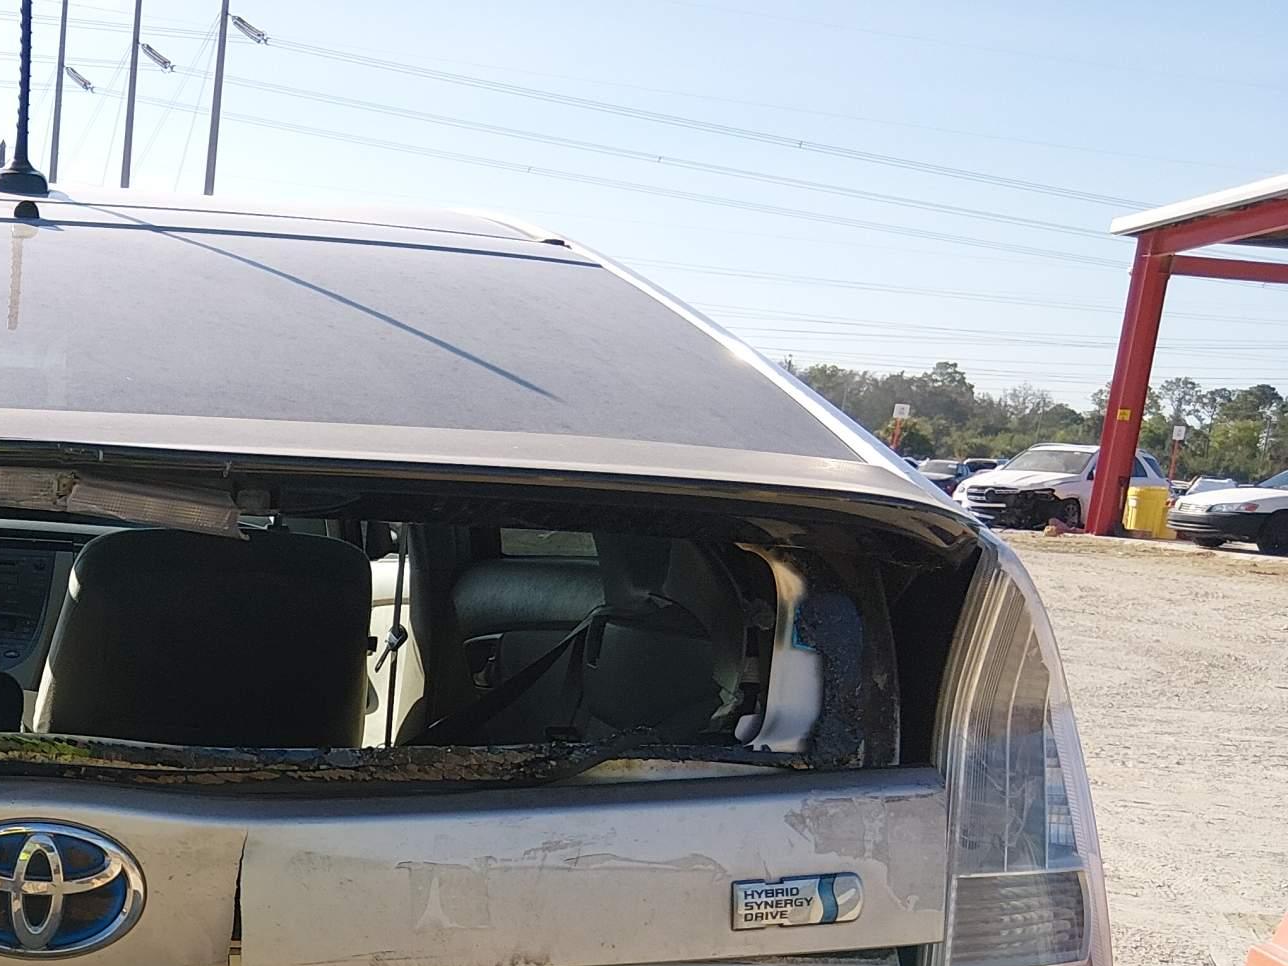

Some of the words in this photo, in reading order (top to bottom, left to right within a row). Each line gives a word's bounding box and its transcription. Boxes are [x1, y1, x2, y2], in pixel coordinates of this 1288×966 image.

[743, 886, 800, 900] HYBRID
[743, 897, 814, 911] SYNERGY
[743, 910, 788, 922] DRIVE
